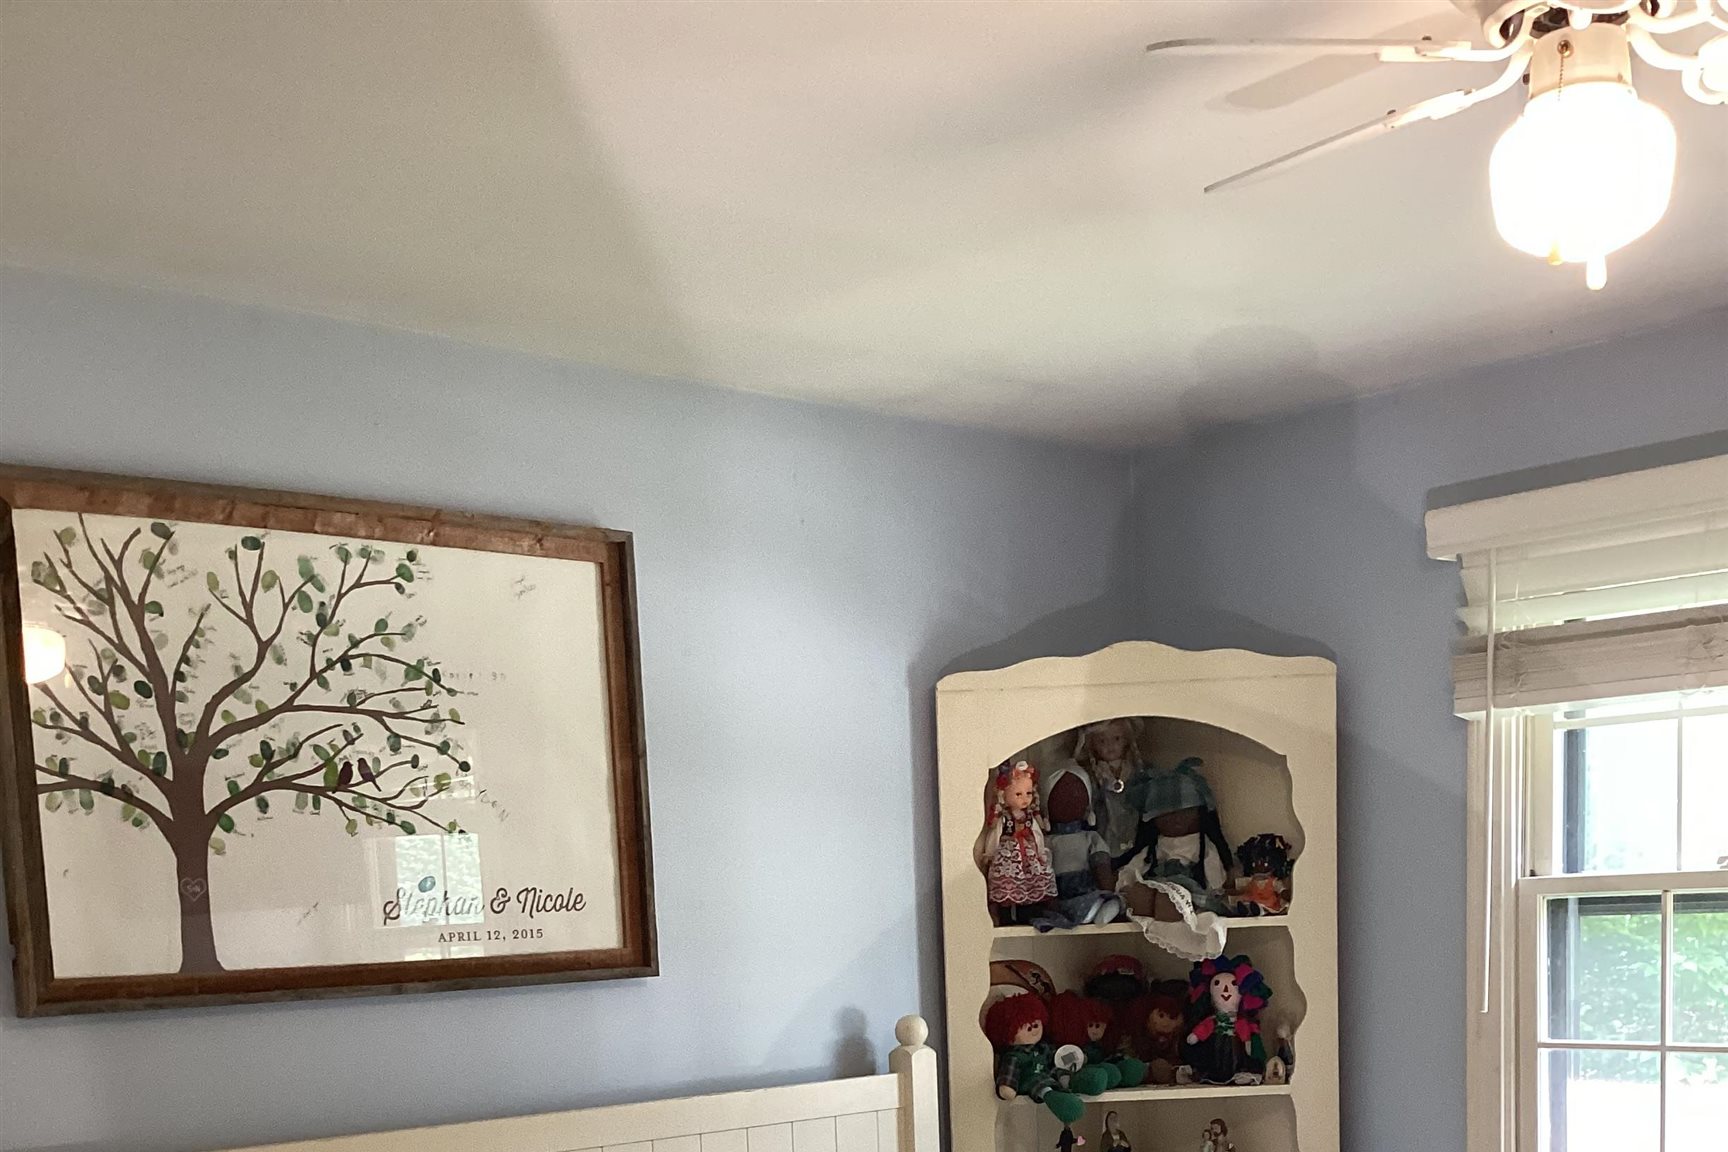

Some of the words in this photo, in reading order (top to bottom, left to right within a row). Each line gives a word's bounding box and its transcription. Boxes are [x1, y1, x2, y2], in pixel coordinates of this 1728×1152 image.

[383, 887, 485, 926] Stephan
[490, 887, 511, 914] &
[516, 887, 587, 919] Nicole
[438, 931, 482, 943] APRIL
[486, 930, 506, 942] 12,
[512, 928, 544, 940] 2015
